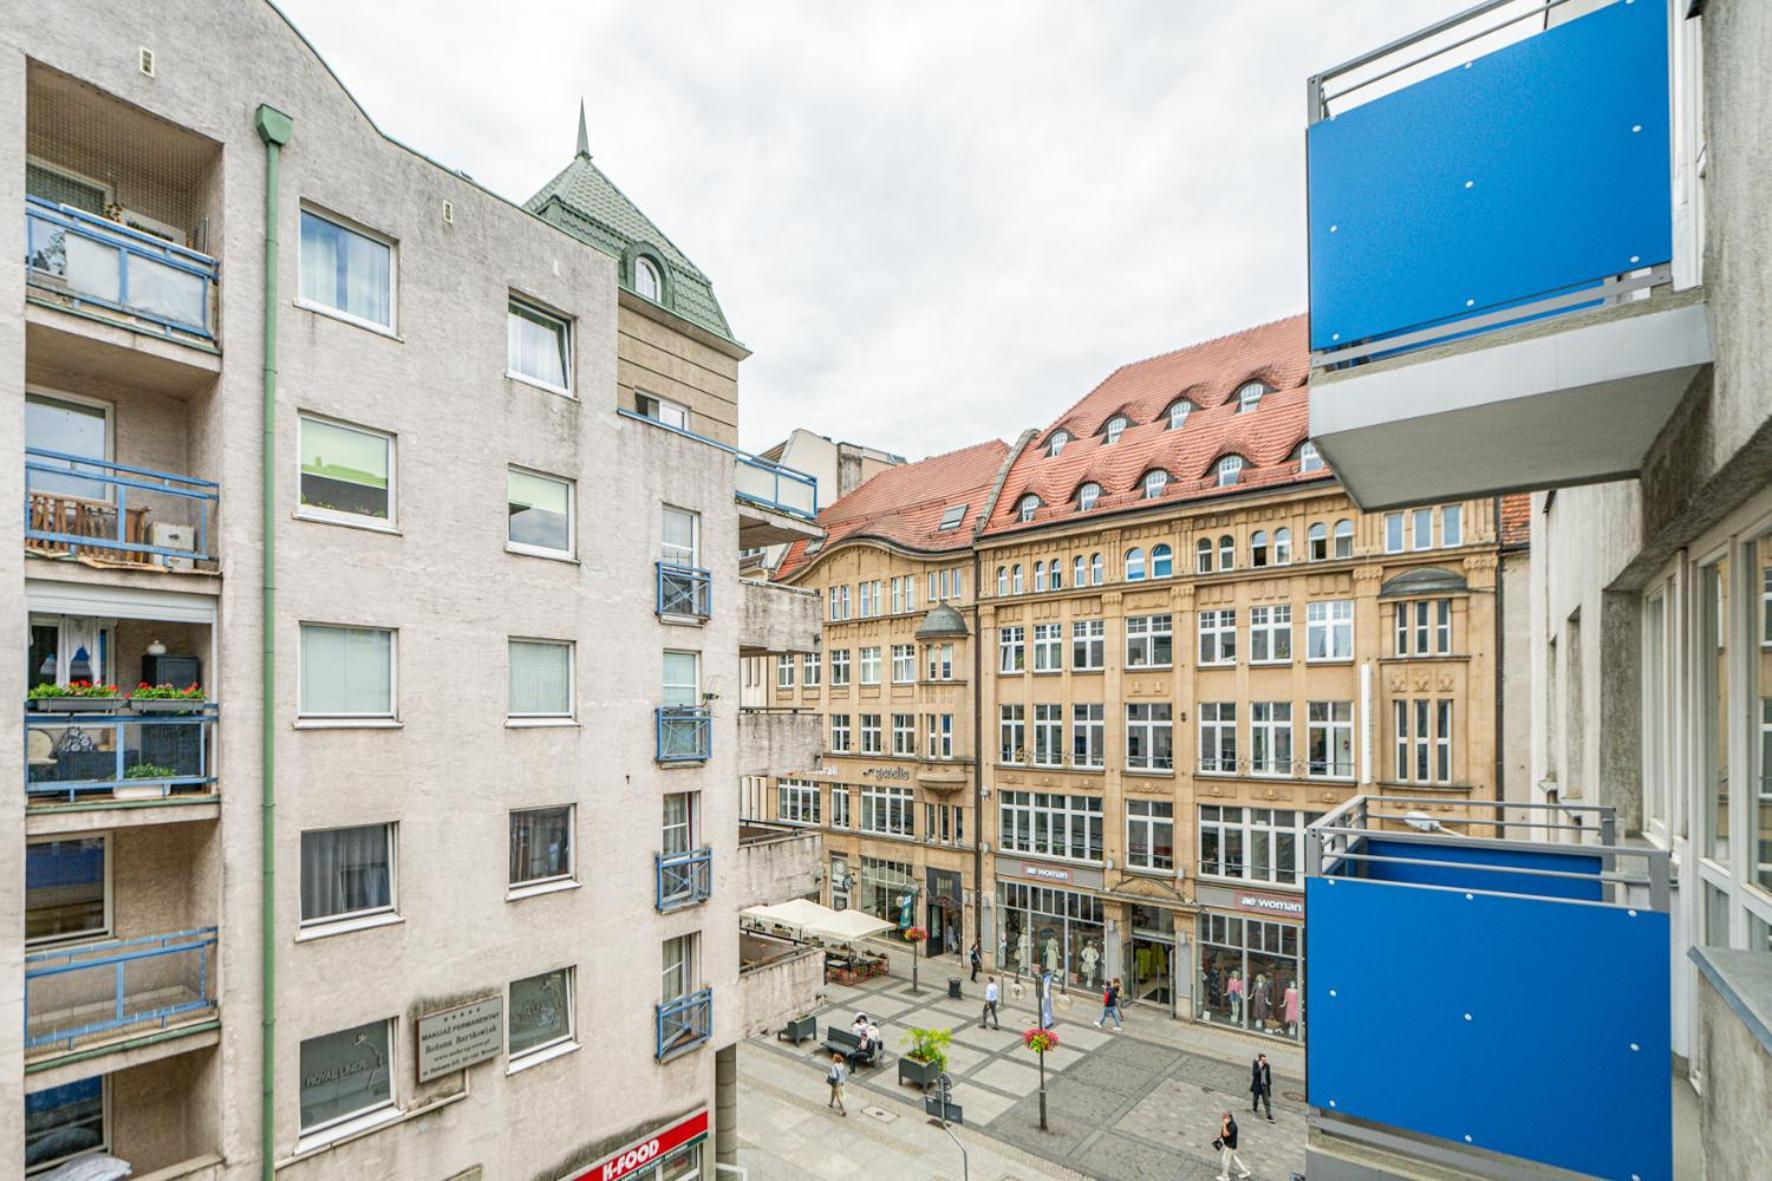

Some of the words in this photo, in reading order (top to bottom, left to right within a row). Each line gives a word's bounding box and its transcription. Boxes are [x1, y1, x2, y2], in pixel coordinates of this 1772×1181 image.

[1241, 896, 1256, 906] ae
[1258, 899, 1302, 912] woman
[602, 1139, 660, 1181] K-FOOD
